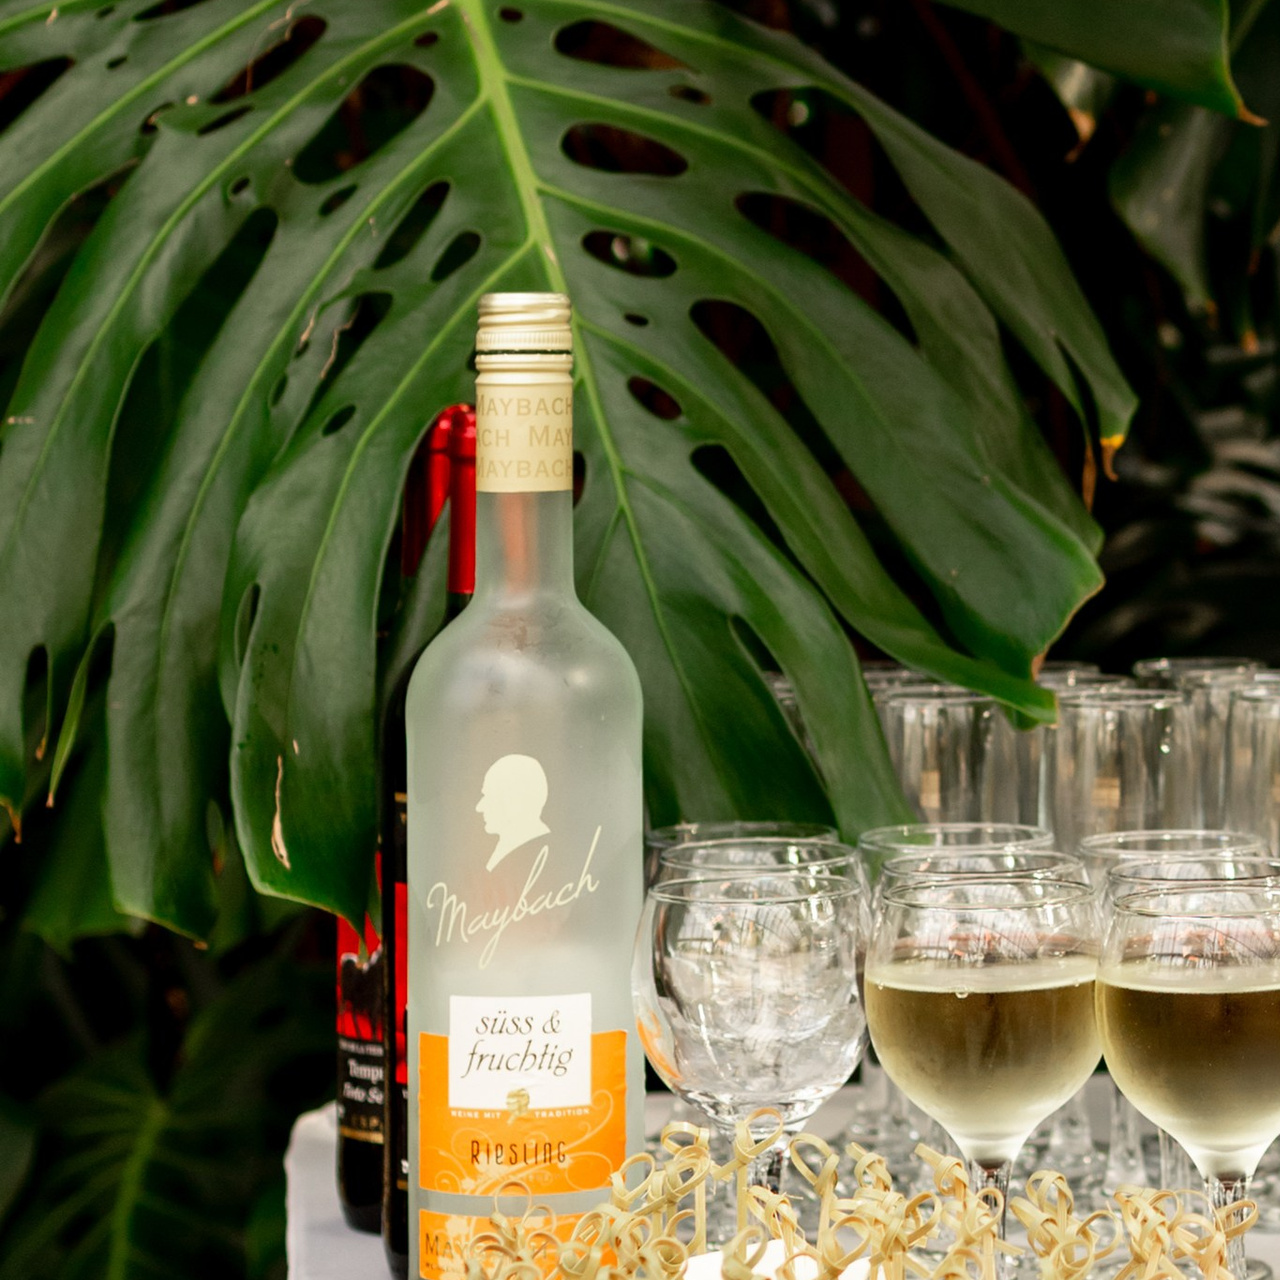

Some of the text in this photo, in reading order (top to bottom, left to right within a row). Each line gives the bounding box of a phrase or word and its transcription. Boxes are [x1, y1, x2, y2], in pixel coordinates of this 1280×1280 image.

[426, 824, 602, 970] Maybach
[475, 1009, 562, 1035] süss &
[460, 1038, 574, 1079] fruchtig
[483, 1111, 502, 1119] MIT
[534, 1108, 591, 1119] TRADITION
